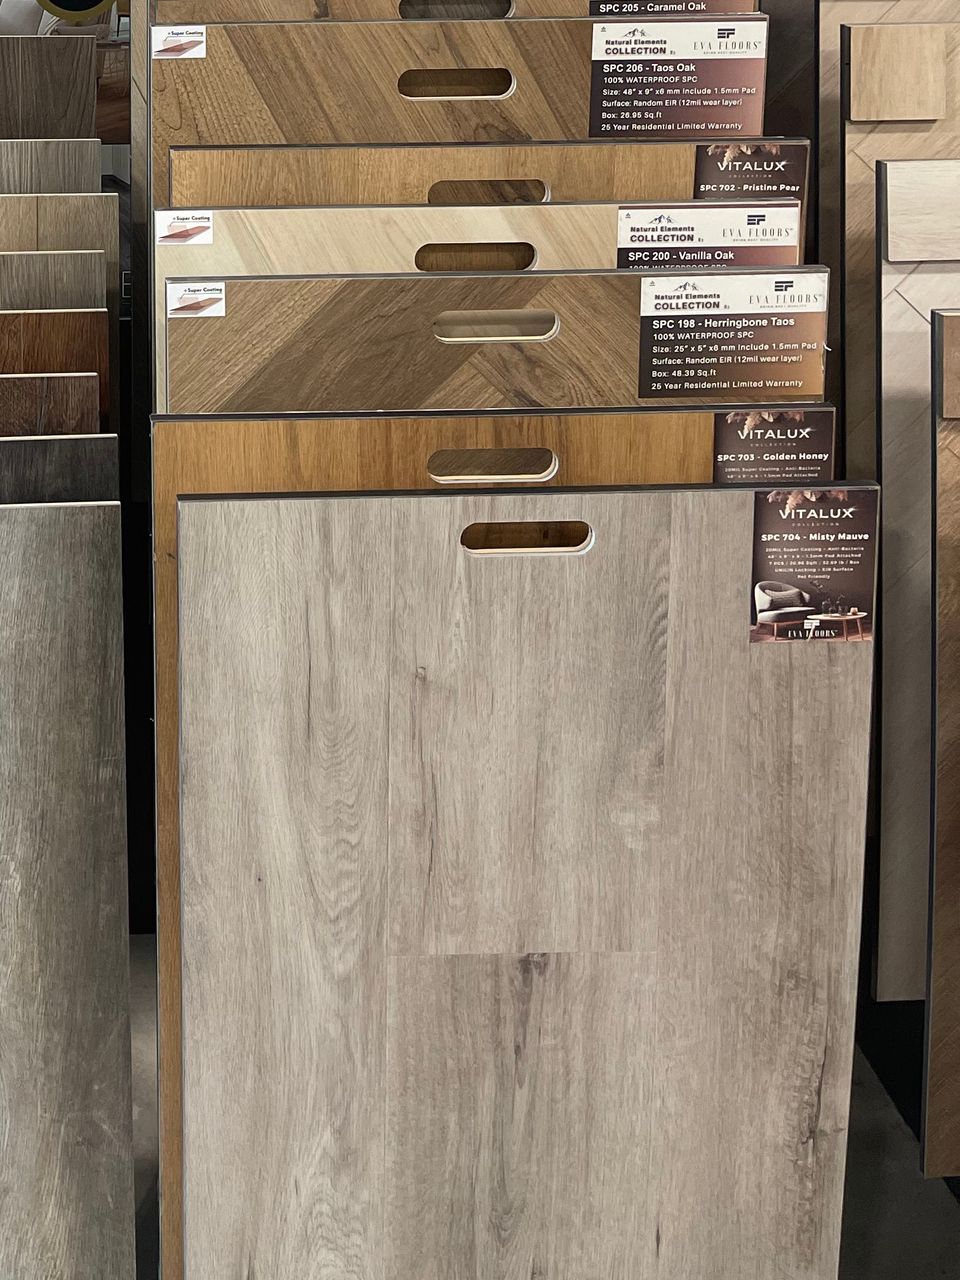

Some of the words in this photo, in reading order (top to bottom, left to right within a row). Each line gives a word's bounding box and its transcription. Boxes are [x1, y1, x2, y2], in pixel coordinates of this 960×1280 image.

[600, 4, 620, 12] SPC
[622, 4, 638, 12] 205
[647, 3, 685, 11] Caramel
[688, 2, 706, 10] Oak
[694, 42, 712, 50] EVA
[719, 41, 758, 49] FLOORS
[626, 64, 643, 72] 206
[652, 64, 674, 72] Taos
[717, 162, 785, 171] VITALUX
[628, 252, 650, 261] SPC
[652, 252, 670, 260] 200
[679, 251, 712, 260] Vanilla
[715, 251, 734, 259] Oak
[655, 301, 720, 310] COLLECTION
[653, 320, 675, 329] SPC
[678, 319, 695, 328] 198
[704, 318, 767, 328] Herringbone
[771, 318, 795, 326] Taos
[738, 428, 810, 439] VITALUX
[763, 453, 796, 461] Golden
[799, 453, 828, 461] Honey
[779, 509, 853, 519] VITALUX
[809, 533, 835, 541] Misty
